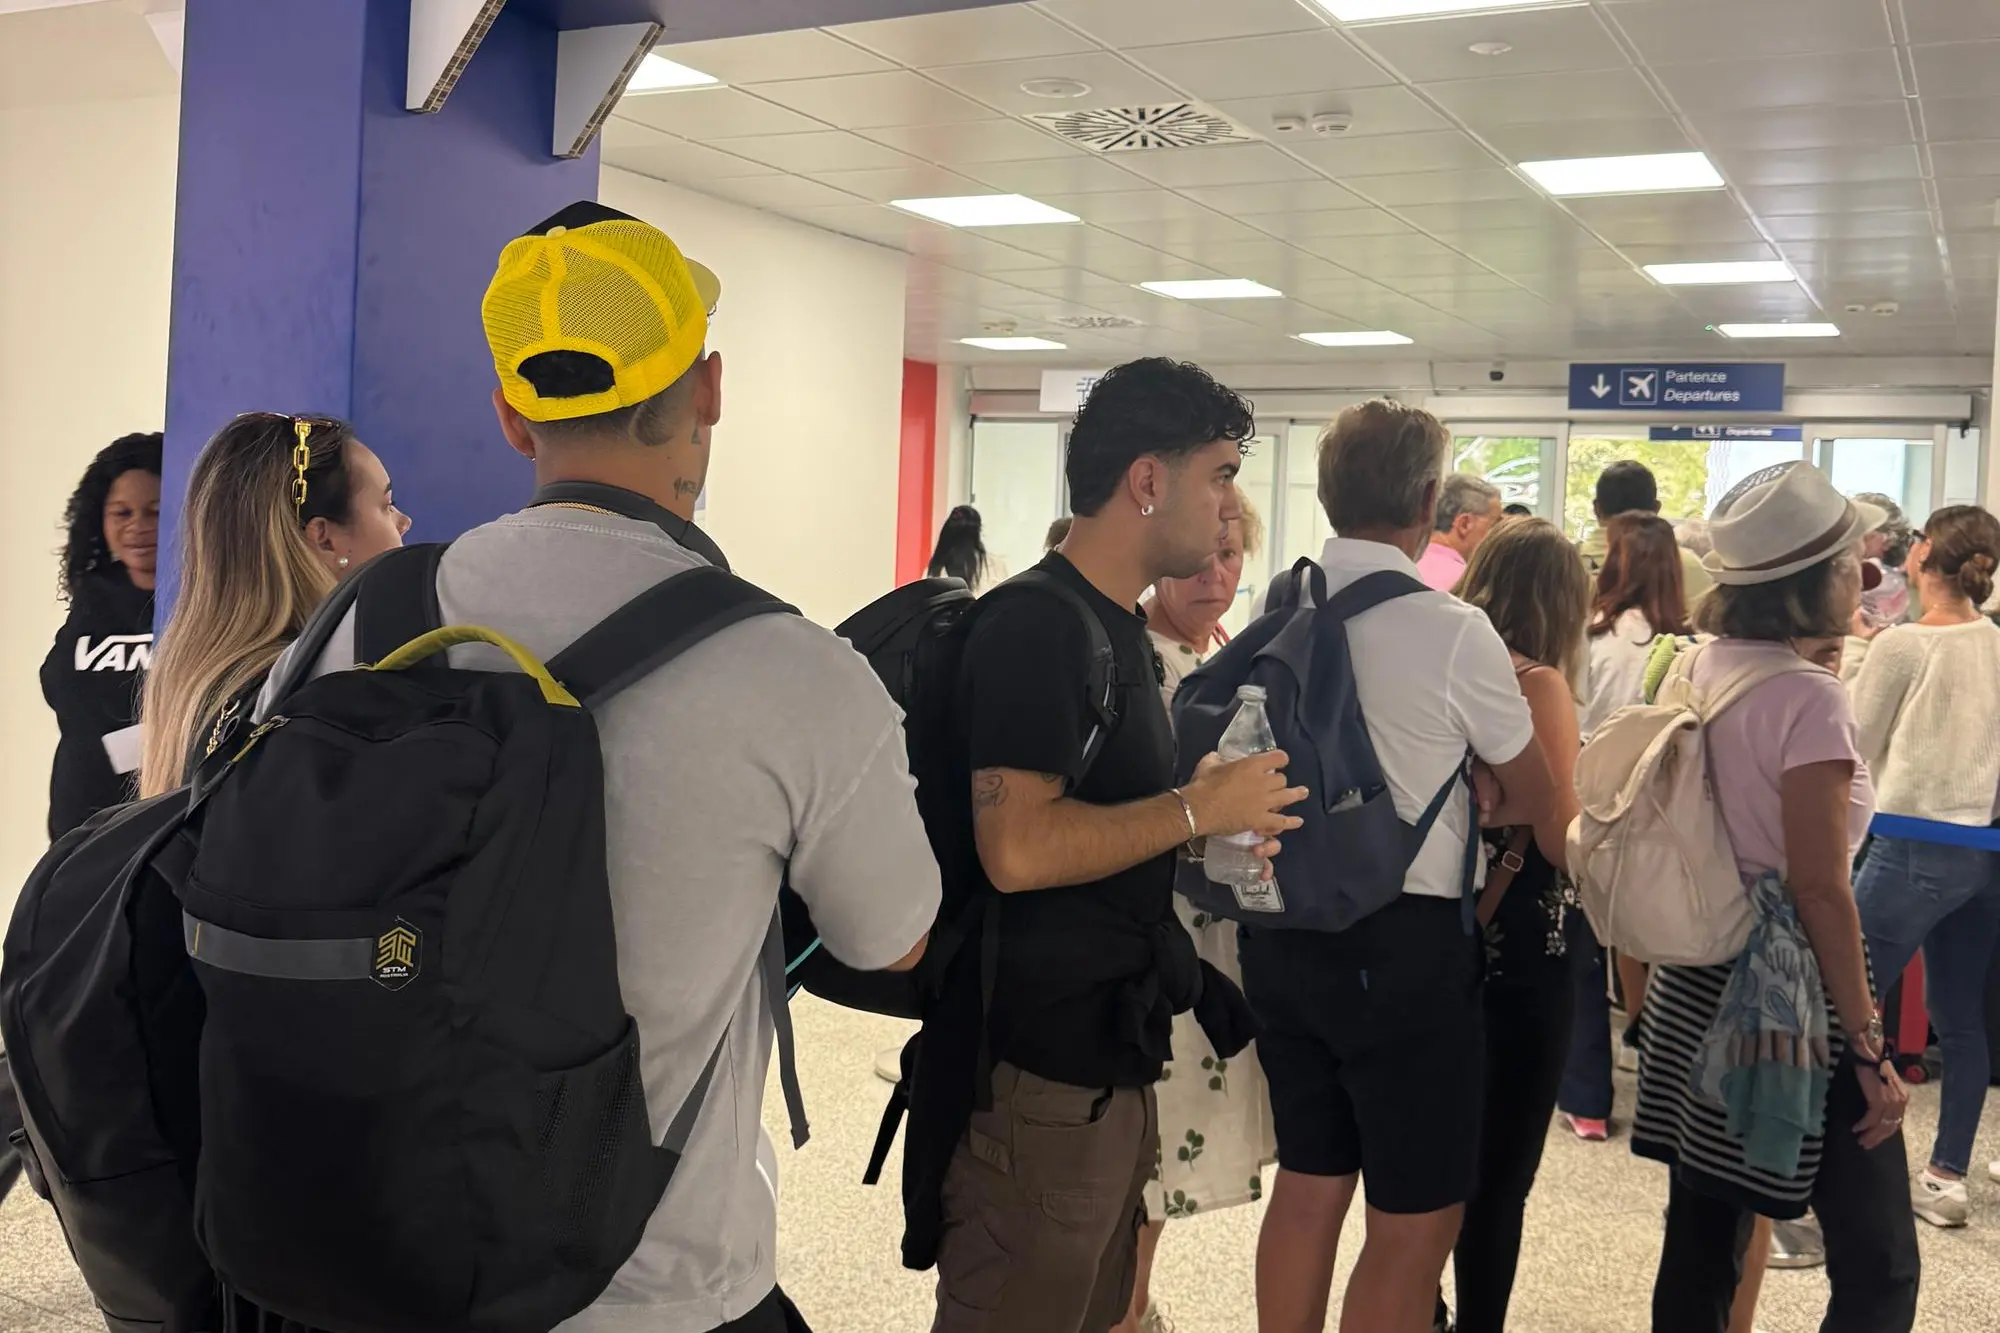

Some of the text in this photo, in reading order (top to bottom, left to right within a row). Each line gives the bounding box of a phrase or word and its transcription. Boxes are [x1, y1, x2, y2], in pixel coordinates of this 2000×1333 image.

[1665, 370, 1727, 384] Partenze
[1664, 388, 1740, 404] Departures
[75, 633, 154, 671] VAN
